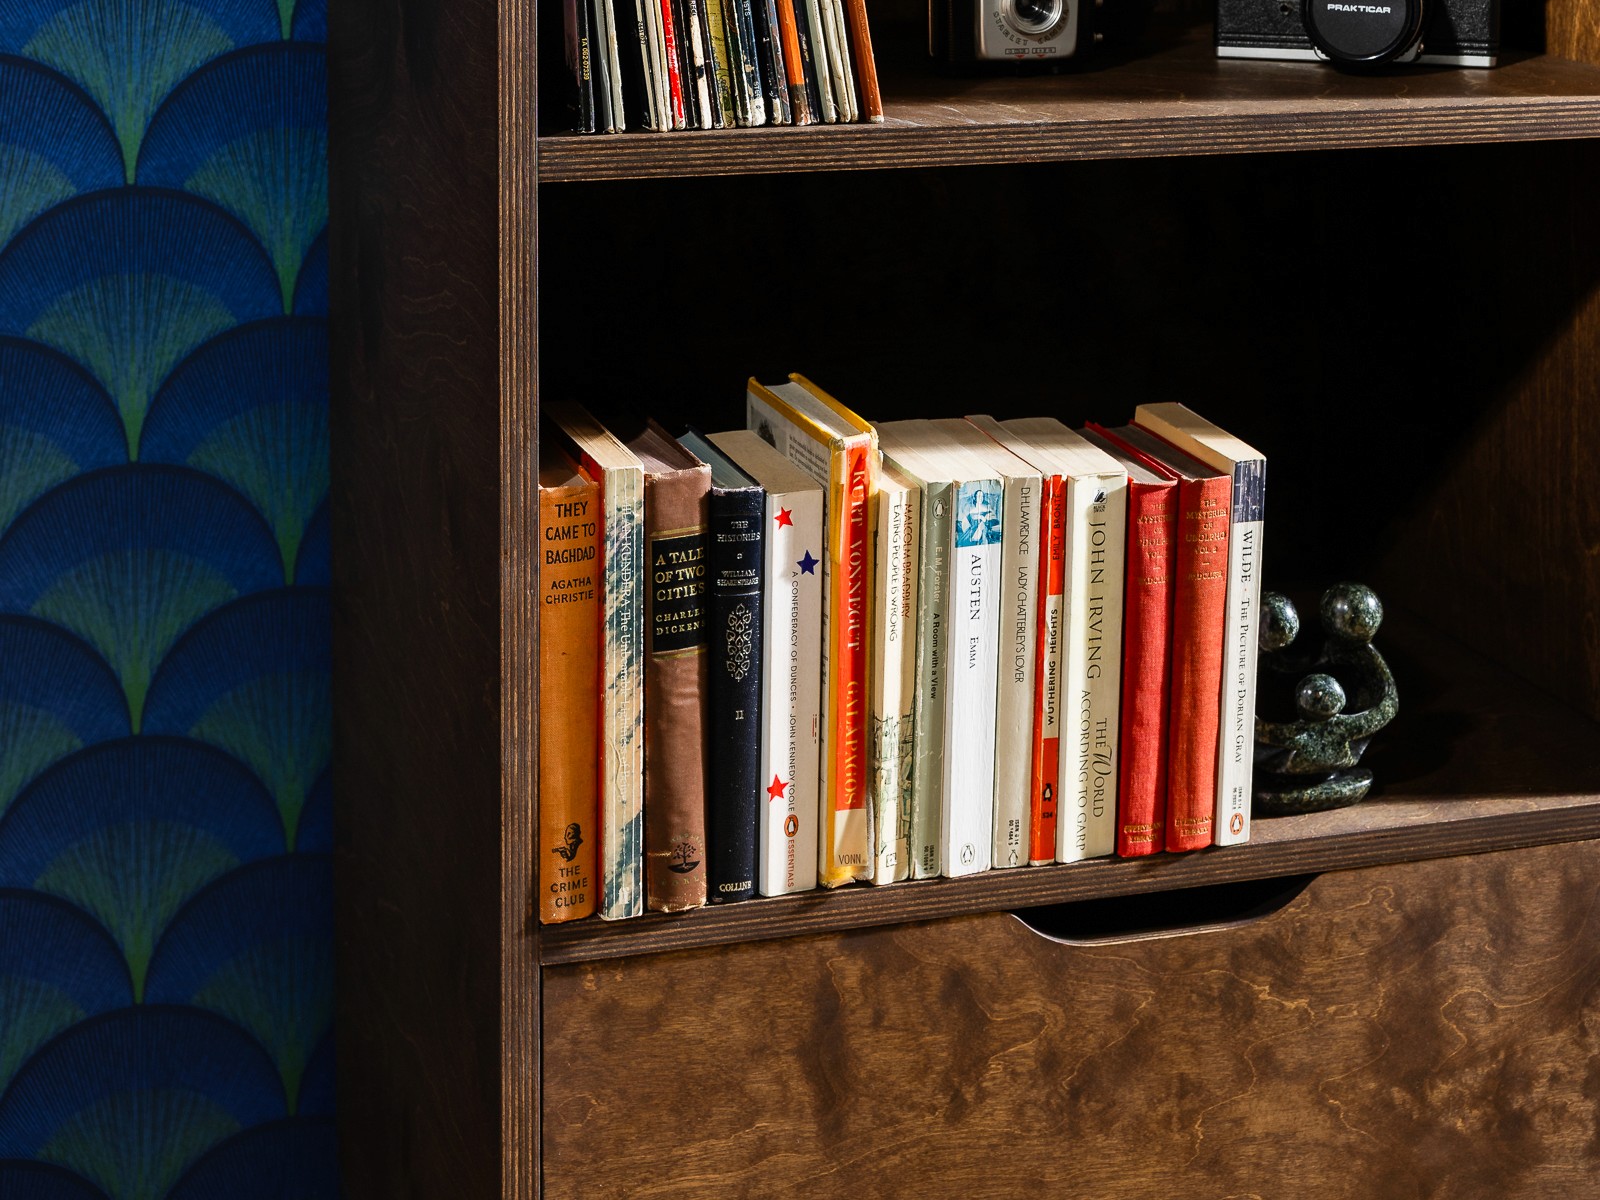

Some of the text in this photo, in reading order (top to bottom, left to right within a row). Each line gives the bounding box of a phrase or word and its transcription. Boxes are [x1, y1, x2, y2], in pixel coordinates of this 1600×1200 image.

[1327, 4, 1391, 13] PRAKTICAR
[581, 38, 587, 46] 1A
[555, 501, 588, 518] THEY
[621, 496, 631, 541] MILAN
[1186, 508, 1226, 520] MYSTERIES
[545, 522, 596, 541] CAME TO
[731, 521, 749, 529] THE
[717, 532, 760, 542] HISTORIES
[1186, 532, 1225, 542] UDOLPHO
[546, 546, 596, 565] BAGHDAD
[656, 547, 704, 566] A TALE
[1053, 536, 1061, 560] EMILY
[901, 504, 912, 618] MALCOLM BRADBURY
[621, 543, 632, 607] KUNDERA
[655, 565, 705, 584] OF TWO
[716, 577, 759, 587] SHAKESPEARE
[721, 569, 756, 578] WILLIAM
[889, 504, 901, 642] EATING PEOPLE IS WRONG
[934, 546, 942, 602] E. M. Forster
[551, 576, 592, 590] AGATHA
[656, 582, 705, 601] CITIES
[545, 590, 594, 604] CHRISTIE
[1086, 521, 1106, 679] JOHN IRVING
[620, 611, 631, 631] The
[790, 580, 798, 647] CONFEDERACY
[969, 554, 981, 669] AUSTEN EMMA
[1015, 566, 1028, 683] LADY CHATTERLEY'S LOVER
[844, 470, 864, 806] KURT VONNEGUT GALAPAGOS
[932, 622, 940, 647] Room
[791, 650, 797, 662] OF
[1235, 530, 1253, 764] WILDE THE PICTURE OF DORIAN GRAY
[620, 634, 630, 695] Unbearable
[930, 677, 938, 699] View
[1048, 661, 1056, 727] WUTHERING
[788, 742, 796, 781] KENNEDY
[1076, 690, 1090, 850] ACCORDING TO GARP
[1092, 718, 1112, 817] THE WORLD
[838, 854, 862, 864] VONN
[558, 866, 580, 877] THE
[550, 878, 588, 893] CRIME
[719, 880, 752, 892] COLLINS
[555, 894, 585, 907] CLUB
